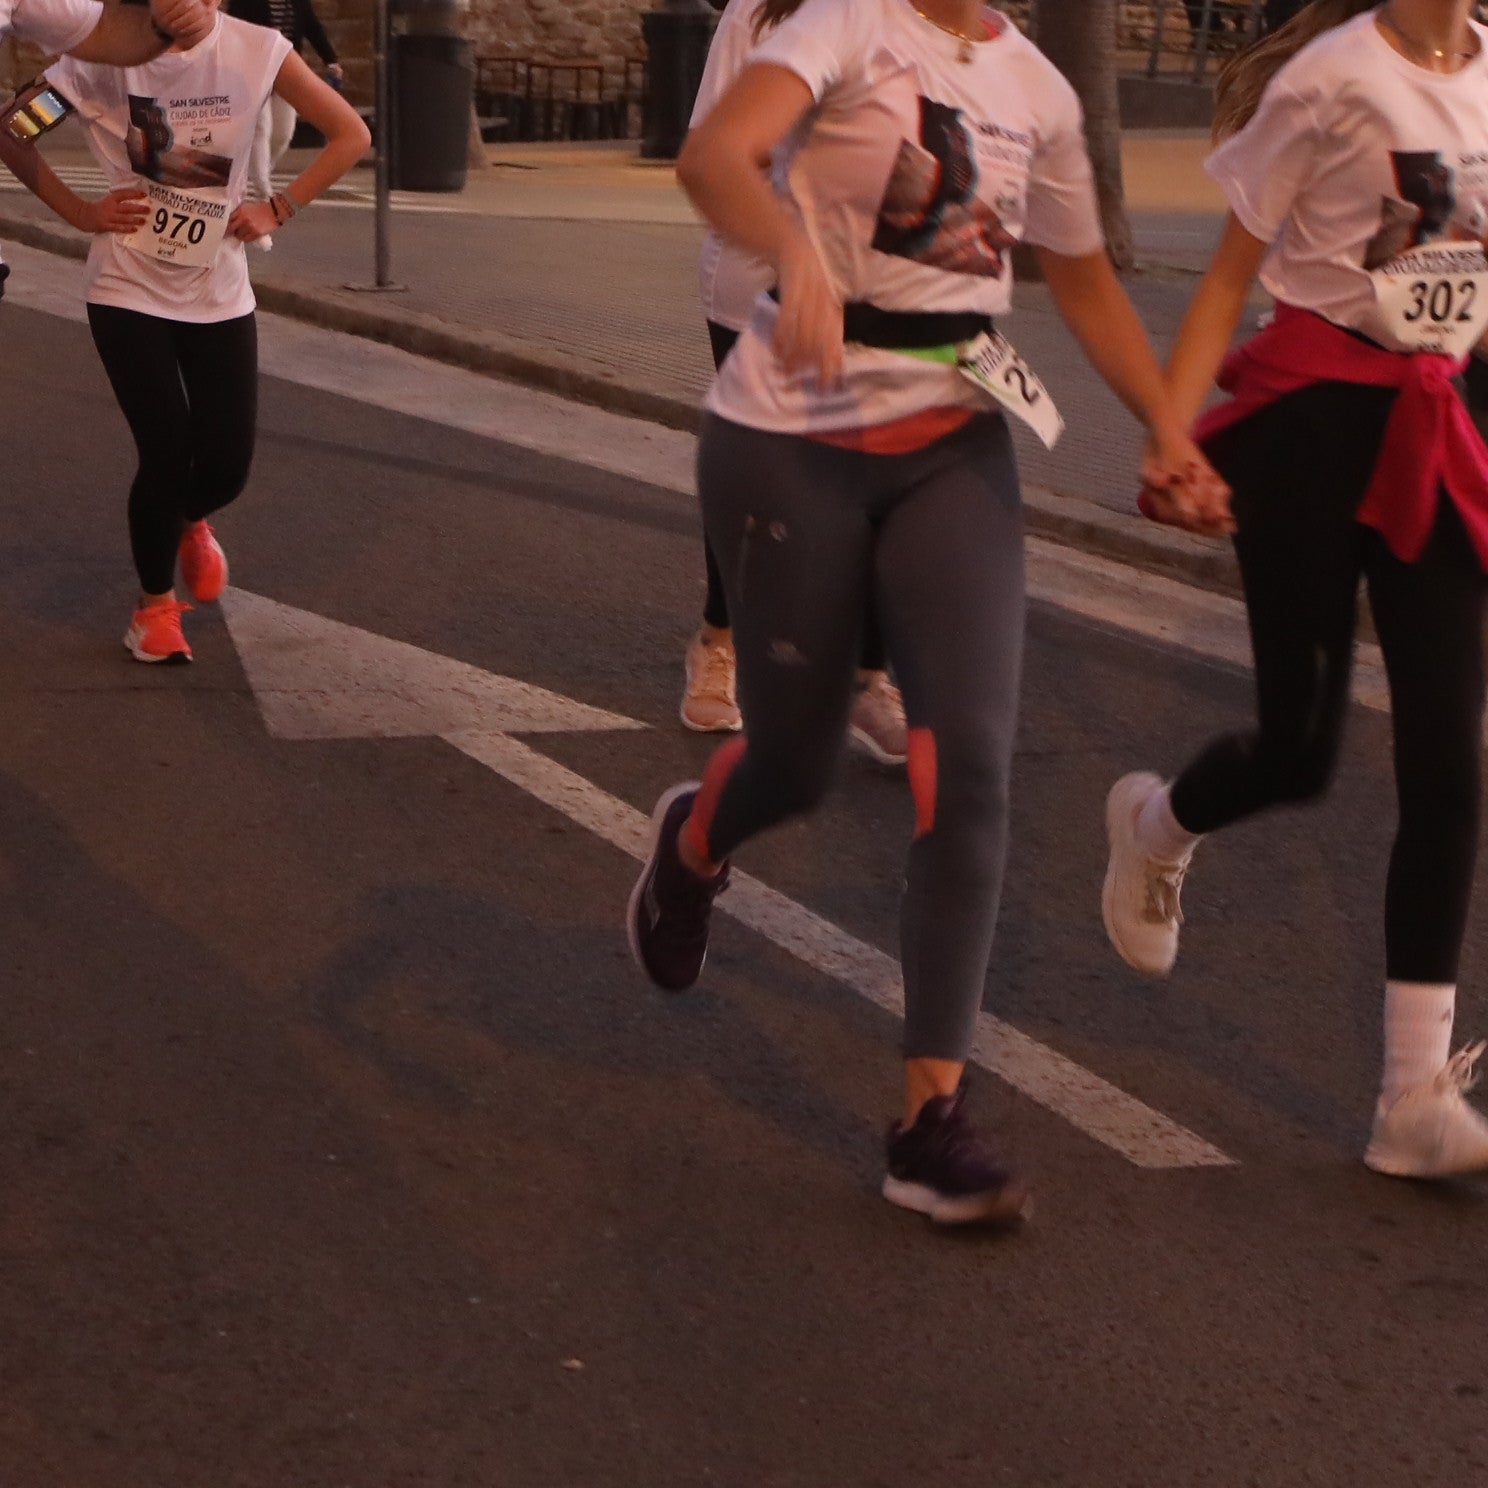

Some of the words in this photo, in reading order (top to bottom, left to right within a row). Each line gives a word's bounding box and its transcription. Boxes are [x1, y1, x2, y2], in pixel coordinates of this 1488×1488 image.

[169, 99, 187, 108] SAN
[188, 96, 230, 107] SILVESTRE
[170, 110, 197, 120] CIUDAD
[199, 109, 208, 118] DE
[171, 192, 226, 210] SILVESTRE
[181, 203, 195, 212] DE
[153, 208, 206, 244] 970
[1404, 280, 1476, 322] 302
